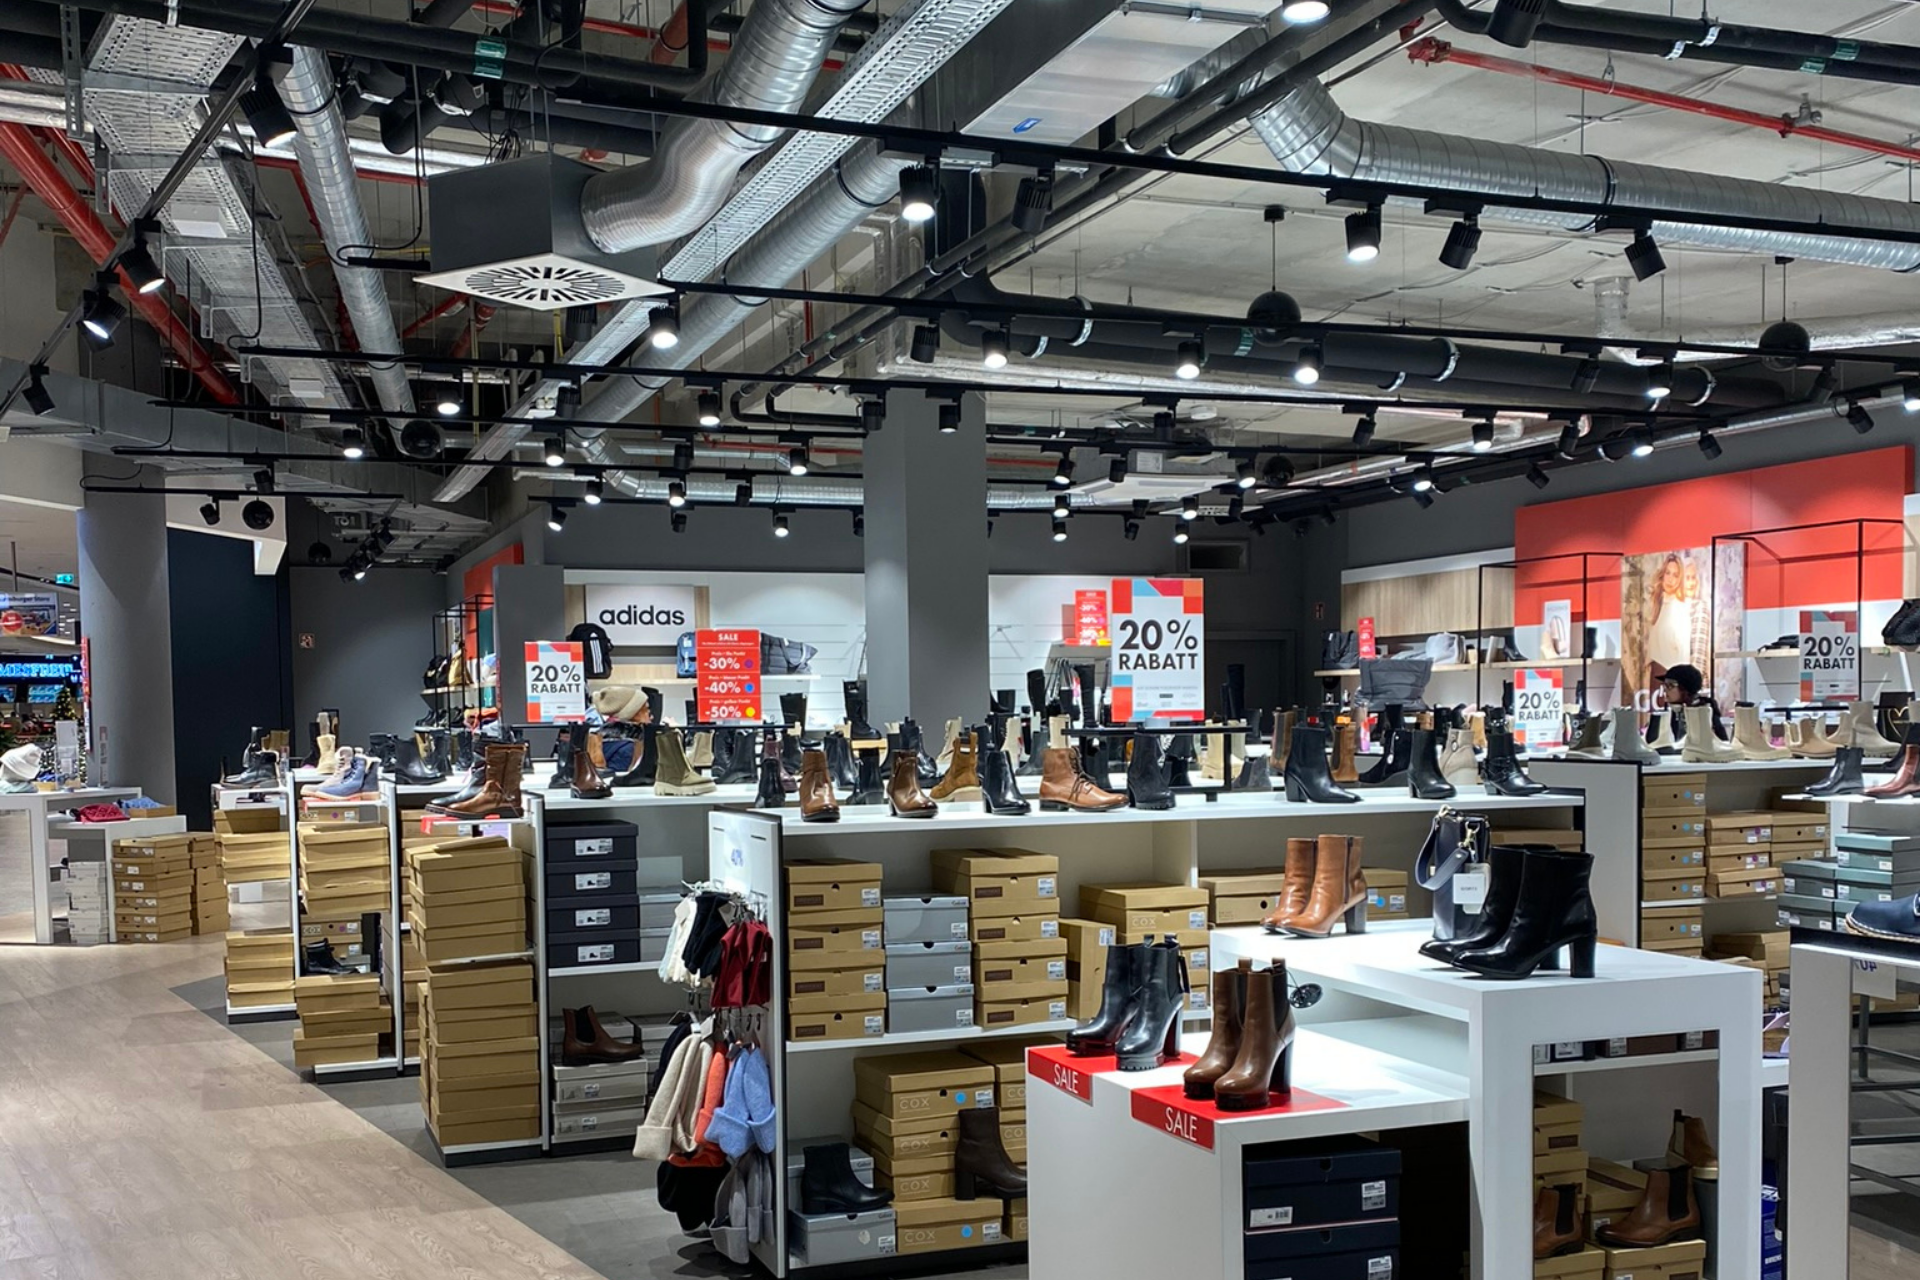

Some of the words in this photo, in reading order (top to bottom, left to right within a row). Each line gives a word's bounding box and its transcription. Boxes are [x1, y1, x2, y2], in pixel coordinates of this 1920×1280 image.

[599, 605, 685, 626] adidas
[718, 633, 739, 642] SALE
[1119, 619, 1198, 651] 20%
[1804, 636, 1855, 657] 20%
[703, 657, 741, 670] -30%
[1119, 653, 1199, 670] RABATT
[1803, 658, 1855, 669] RABATT
[531, 665, 581, 683] 20%
[531, 683, 581, 694] RABATT
[704, 681, 742, 694] -40%
[1519, 691, 1560, 709] 20%
[705, 705, 742, 718] -50%
[1519, 710, 1561, 720] RABATT
[1132, 917, 1156, 927] COX
[1053, 1063, 1079, 1094] SALE
[1007, 1087, 1026, 1099] CO
[900, 1097, 930, 1110] COX
[1165, 1107, 1197, 1141] SALE
[1004, 1128, 1024, 1139] CO
[900, 1139, 931, 1152] COX
[900, 1178, 931, 1192] COX
[904, 1230, 936, 1243] COX
